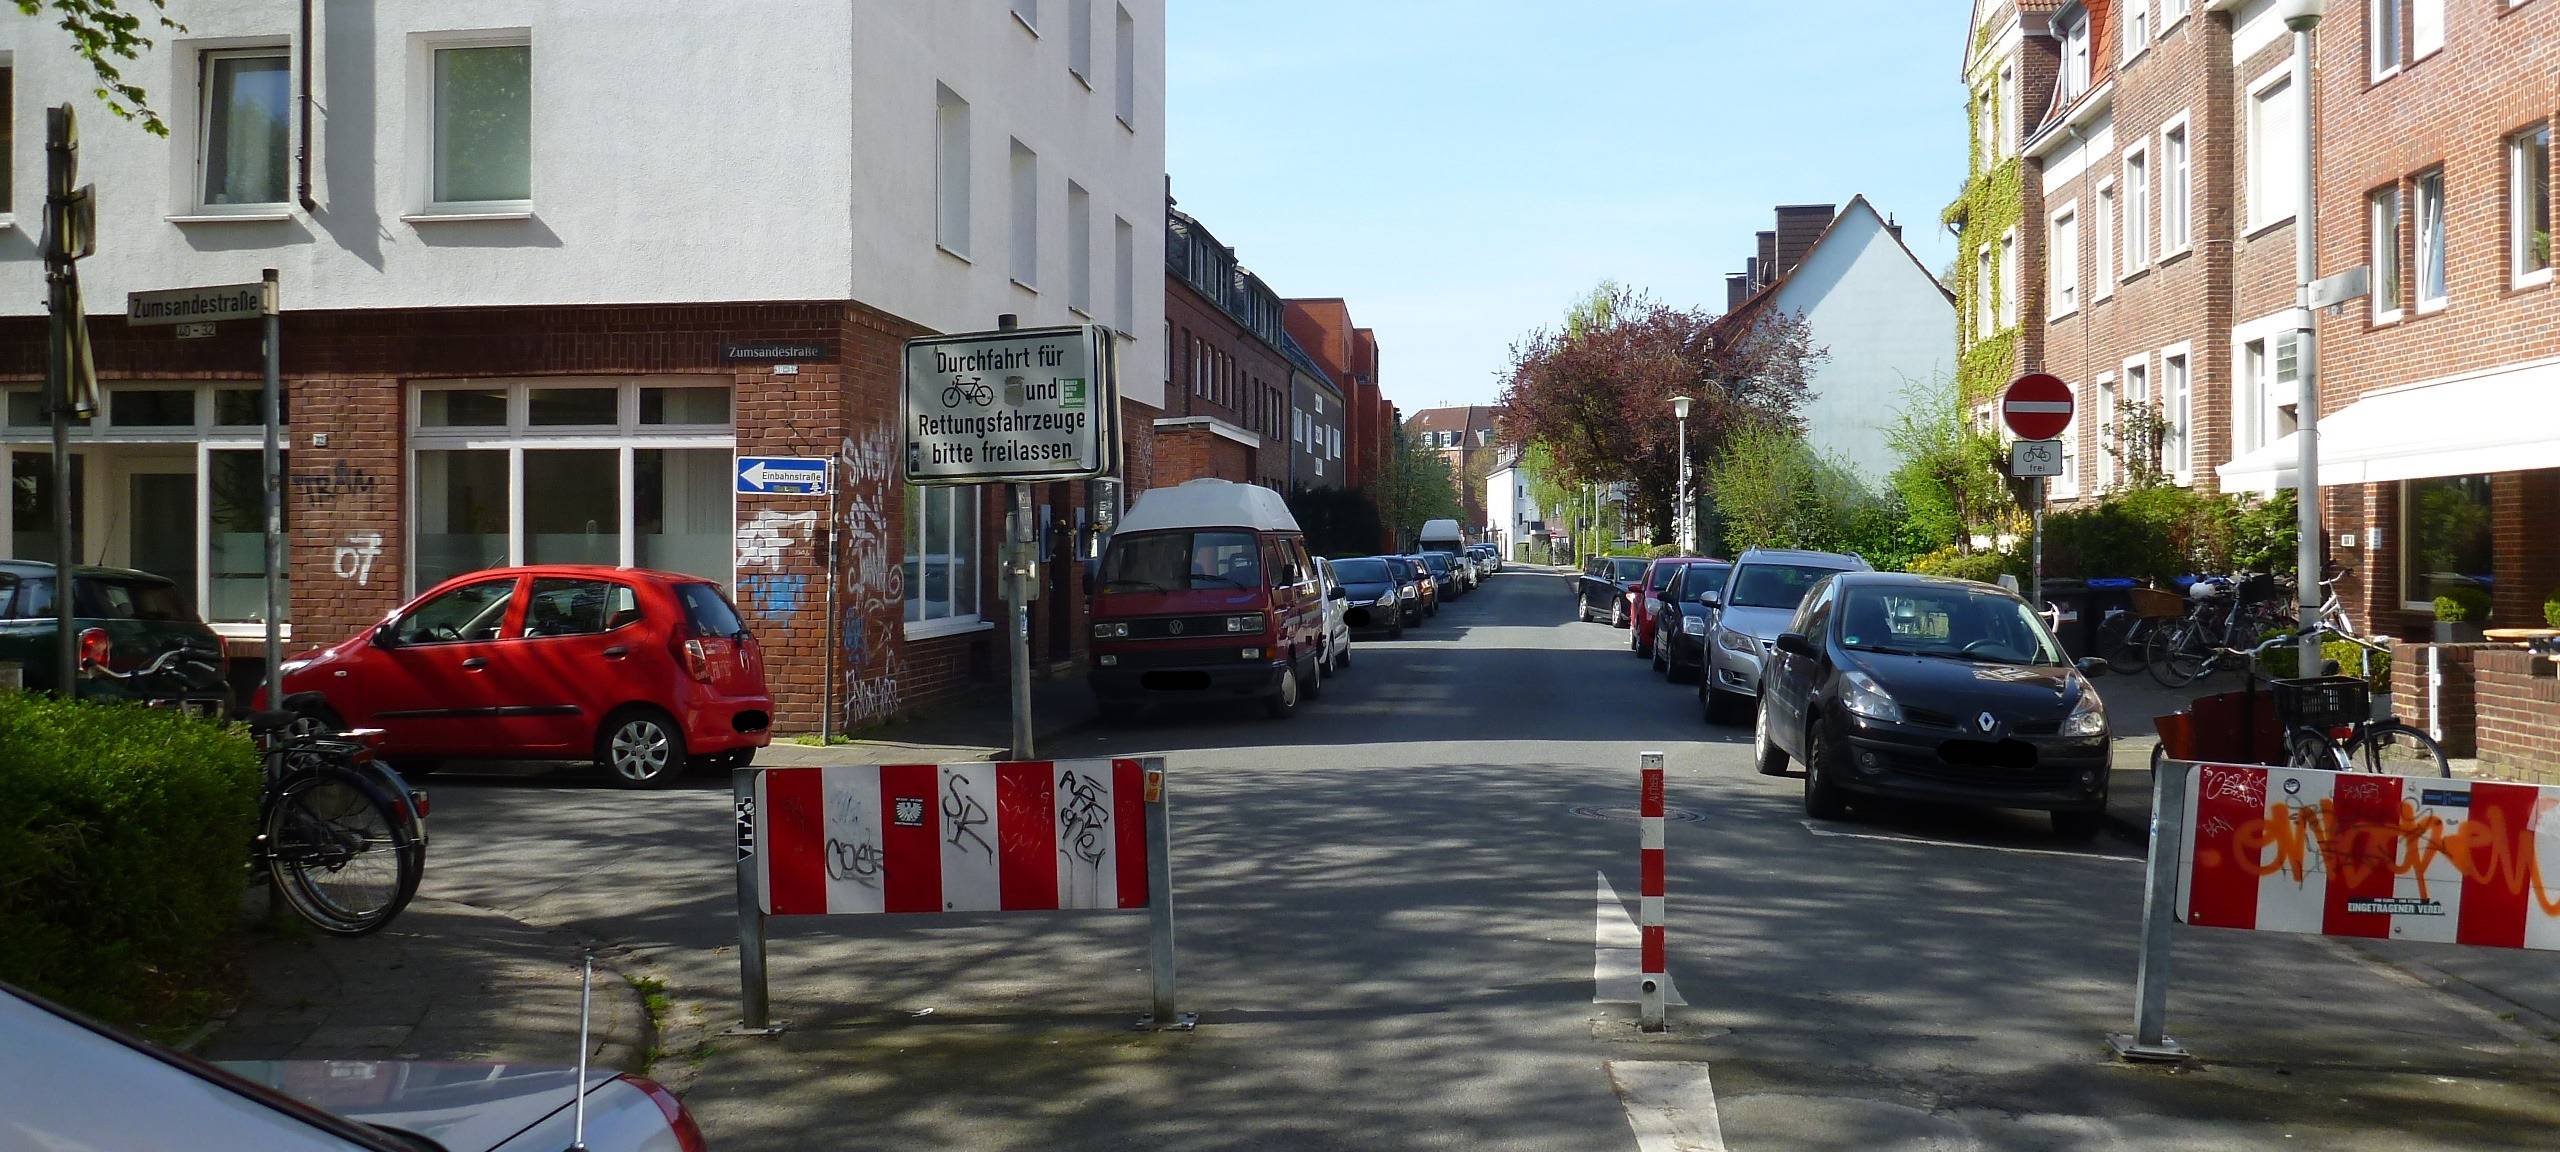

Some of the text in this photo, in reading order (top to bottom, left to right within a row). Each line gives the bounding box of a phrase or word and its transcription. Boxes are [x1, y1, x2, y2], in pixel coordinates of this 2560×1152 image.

[133, 291, 257, 318] Zumsandestraße
[728, 346, 819, 358] Zumsandestraße
[936, 344, 1064, 374] Durchfahrt für
[1026, 376, 1057, 400] und
[918, 409, 1086, 439] Rettungsfahrzeuge
[932, 438, 1073, 465] bitte freilassen
[762, 471, 822, 481] Einbahnstraße
[2029, 463, 2046, 472] frei
